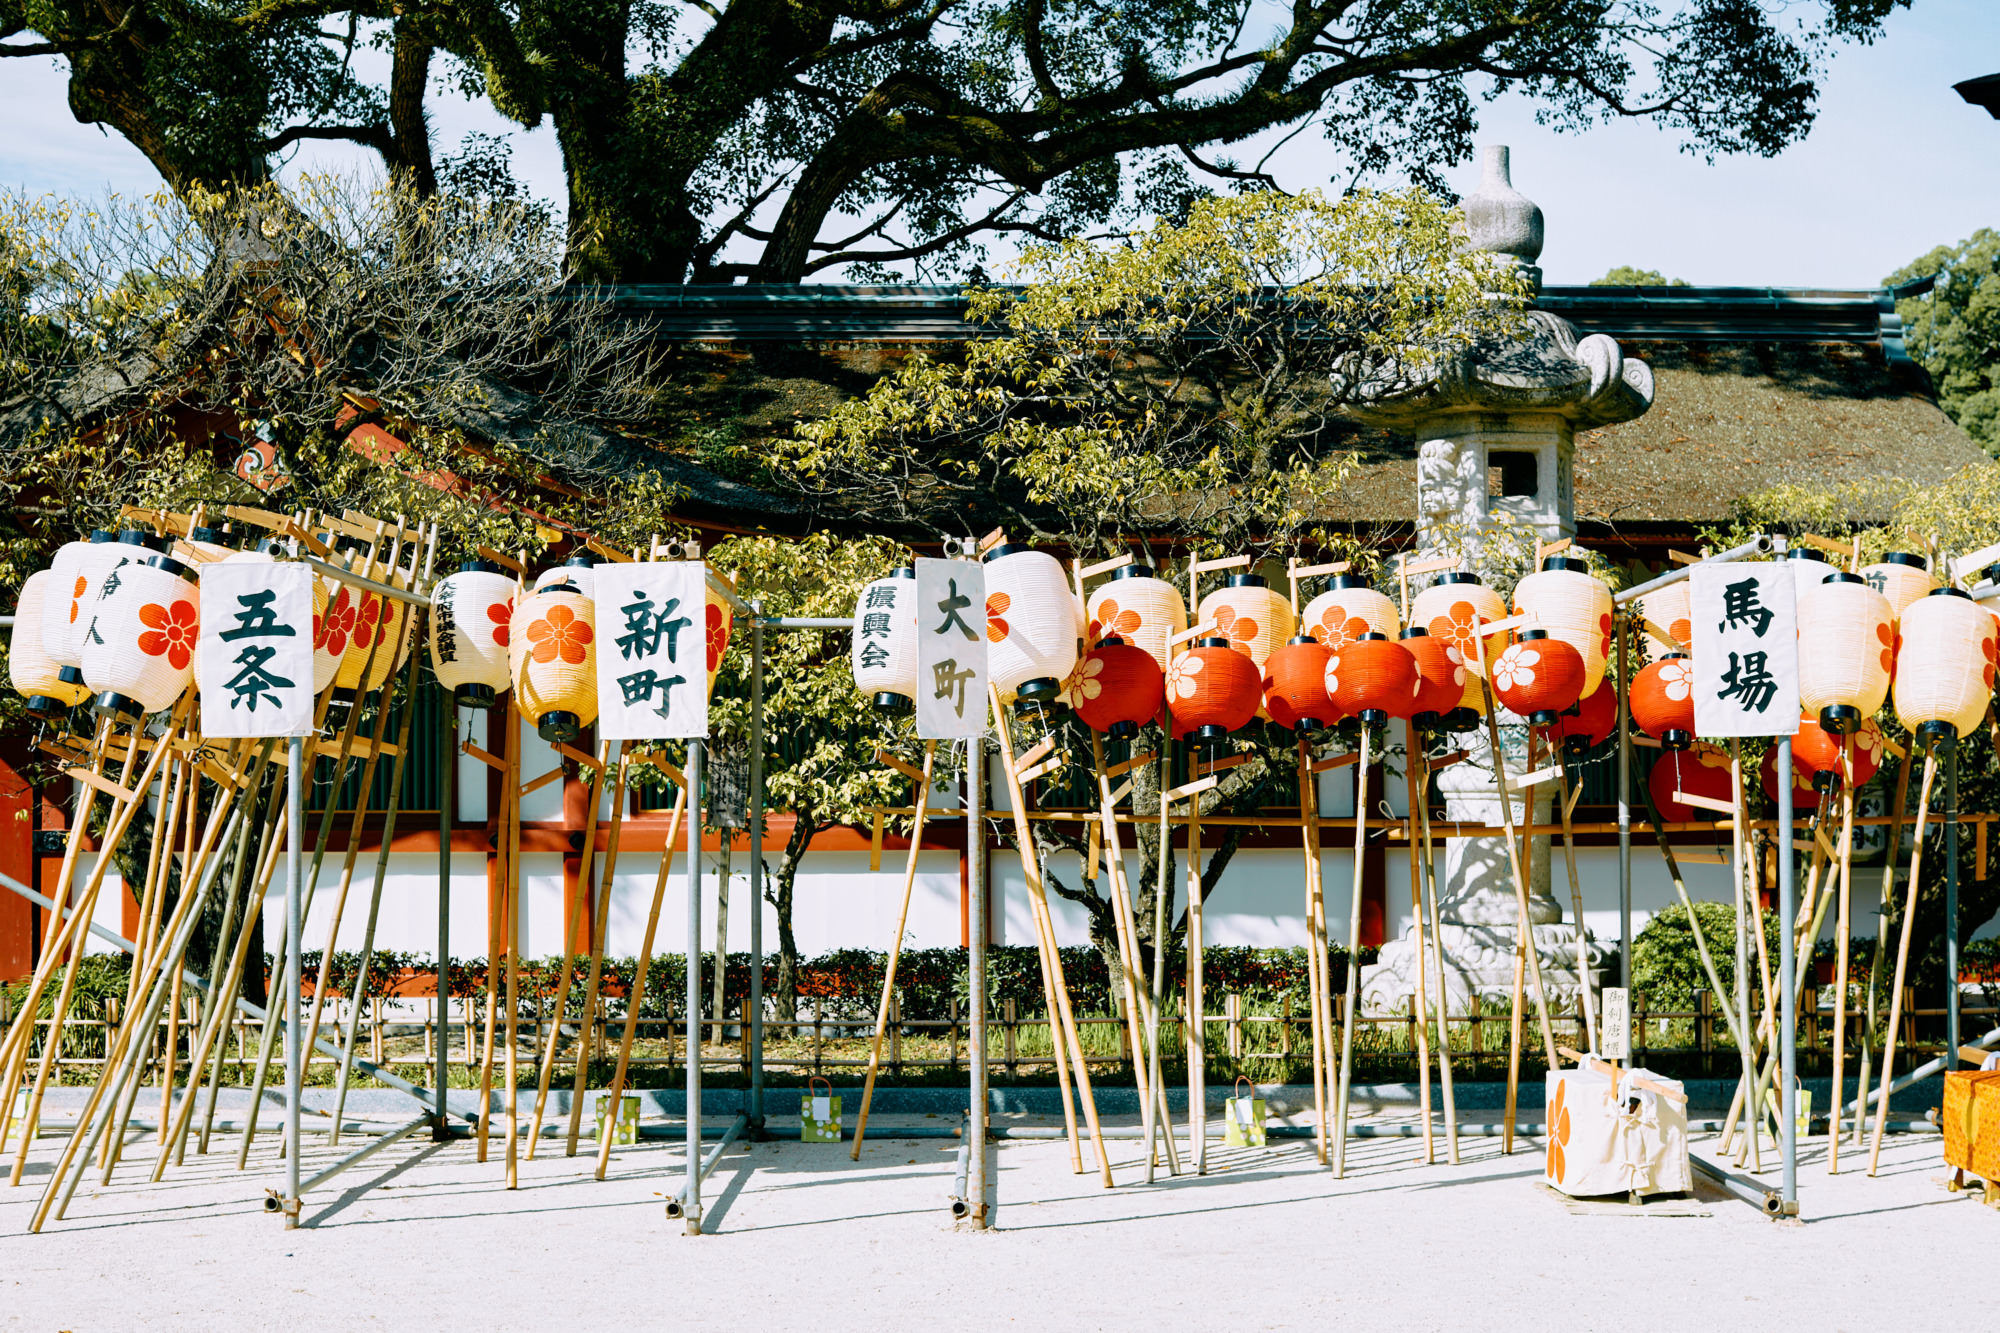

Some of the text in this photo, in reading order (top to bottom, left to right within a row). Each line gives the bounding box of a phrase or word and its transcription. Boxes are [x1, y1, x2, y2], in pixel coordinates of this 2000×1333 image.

[219, 588, 296, 712] 五条
[614, 590, 692, 720] 新町
[859, 586, 897, 669] 振興会
[932, 577, 980, 719] 大町
[1717, 577, 1778, 714] 馬場
